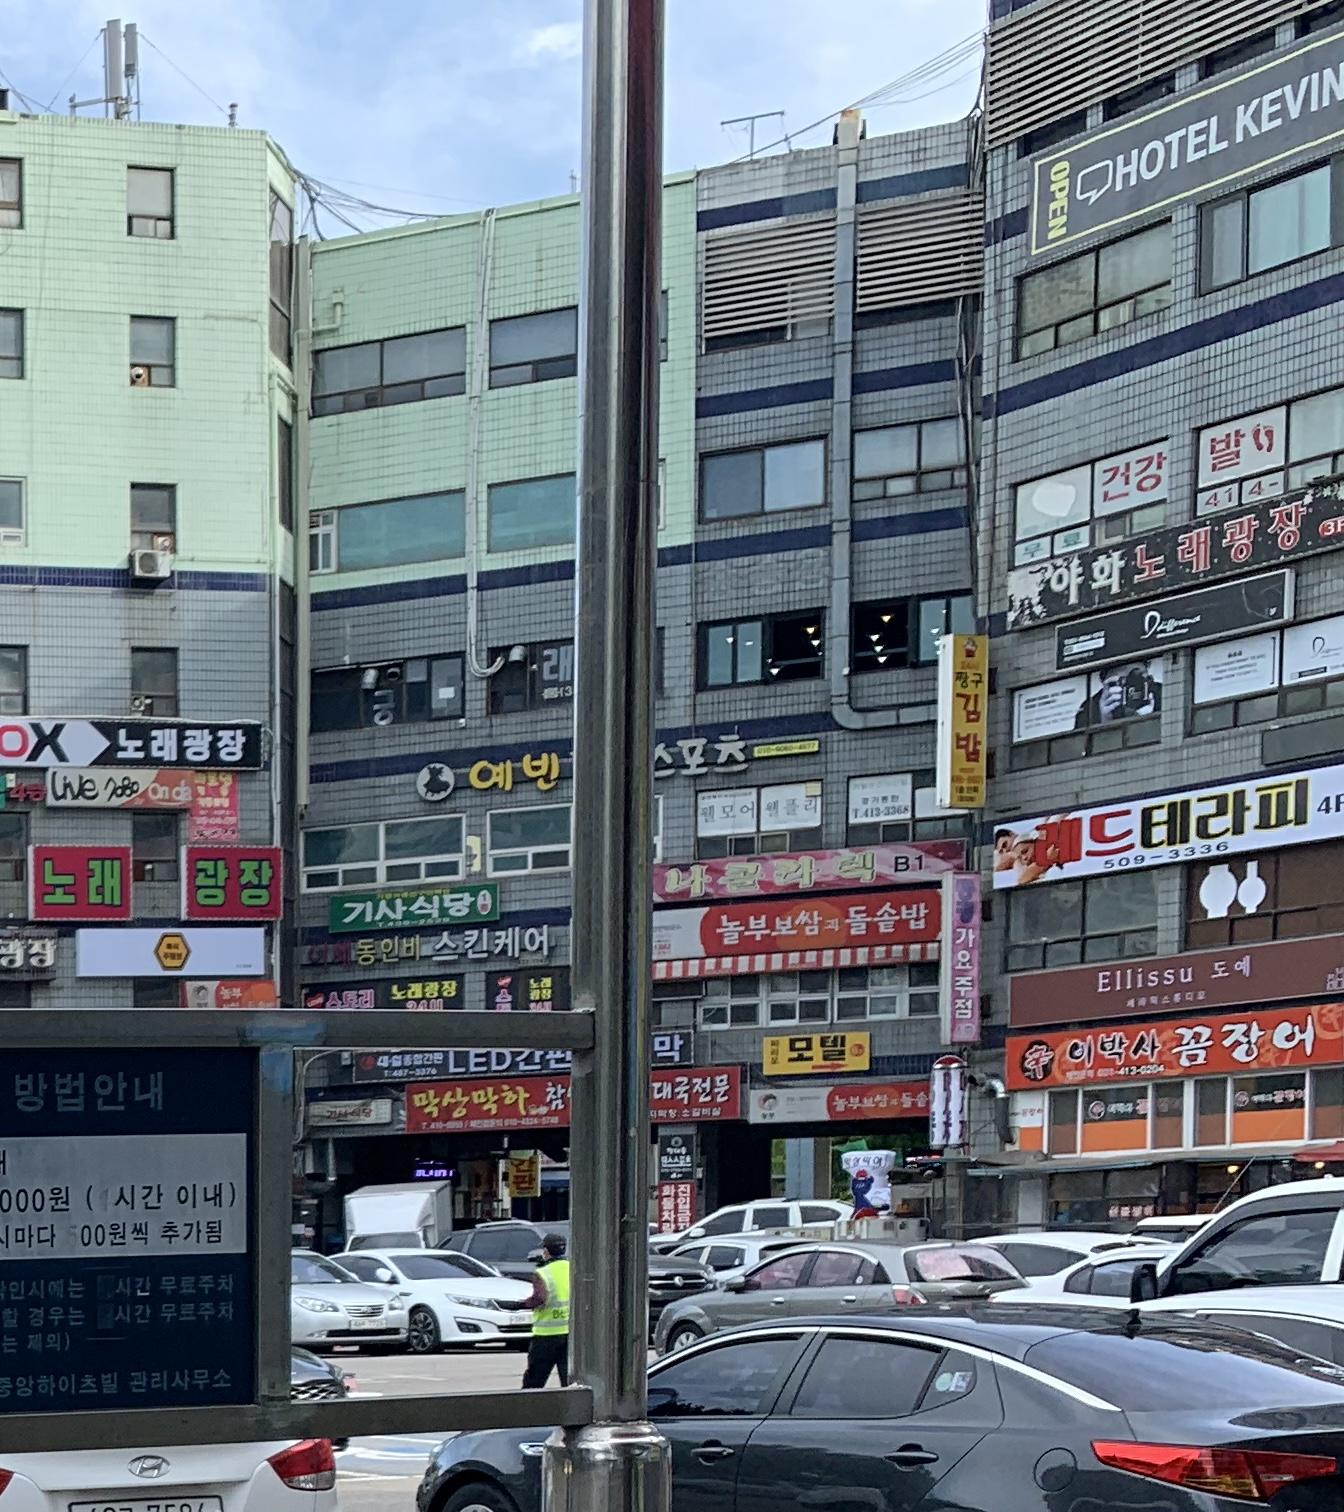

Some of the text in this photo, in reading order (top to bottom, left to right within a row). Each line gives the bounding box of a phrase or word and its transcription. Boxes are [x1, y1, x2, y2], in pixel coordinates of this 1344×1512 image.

[1116, 62, 1344, 191] HOTEL KEVIN
[1048, 161, 1070, 239] OPEN
[1102, 429, 1245, 502] 건강 발
[1050, 549, 1125, 604] 야화
[1135, 501, 1306, 584] 노래광장
[116, 727, 246, 762] 노래광장
[956, 693, 982, 763] 김밥
[51, 771, 99, 802] Live
[469, 752, 561, 792] 예빈
[1034, 777, 1310, 868] 레드테라피
[895, 855, 924, 874] B1
[1103, 840, 1229, 871] 509-3336
[43, 858, 122, 907] 노래
[194, 858, 274, 907] 광장
[343, 891, 475, 924] 기사식당
[845, 903, 929, 933] 돌솥밥
[356, 934, 422, 966] 동인비
[432, 925, 549, 961] 스킨케어
[955, 928, 976, 1020] 가요주점
[1097, 955, 1252, 992] Ellissu 도예
[325, 980, 457, 1009] 스토리 노래광장
[788, 1035, 847, 1063] 모텔
[1066, 1013, 1316, 1069] 이박사 꼼장어
[15, 1071, 164, 1113] 방법안내
[413, 1084, 531, 1119] 막상막하
[652, 1073, 730, 1105] 대국전문
[114, 1184, 163, 1210] 시간
[177, 1182, 238, 1210] 이내)
[160, 1219, 224, 1245] 추가됨
[115, 1275, 151, 1297] 시간
[160, 1274, 234, 1296] 무료주차
[28, 1306, 85, 1328] 경우는
[115, 1303, 151, 1324] 시간
[160, 1301, 234, 1322] 무료주차
[130, 1369, 232, 1393] 관리사무소
